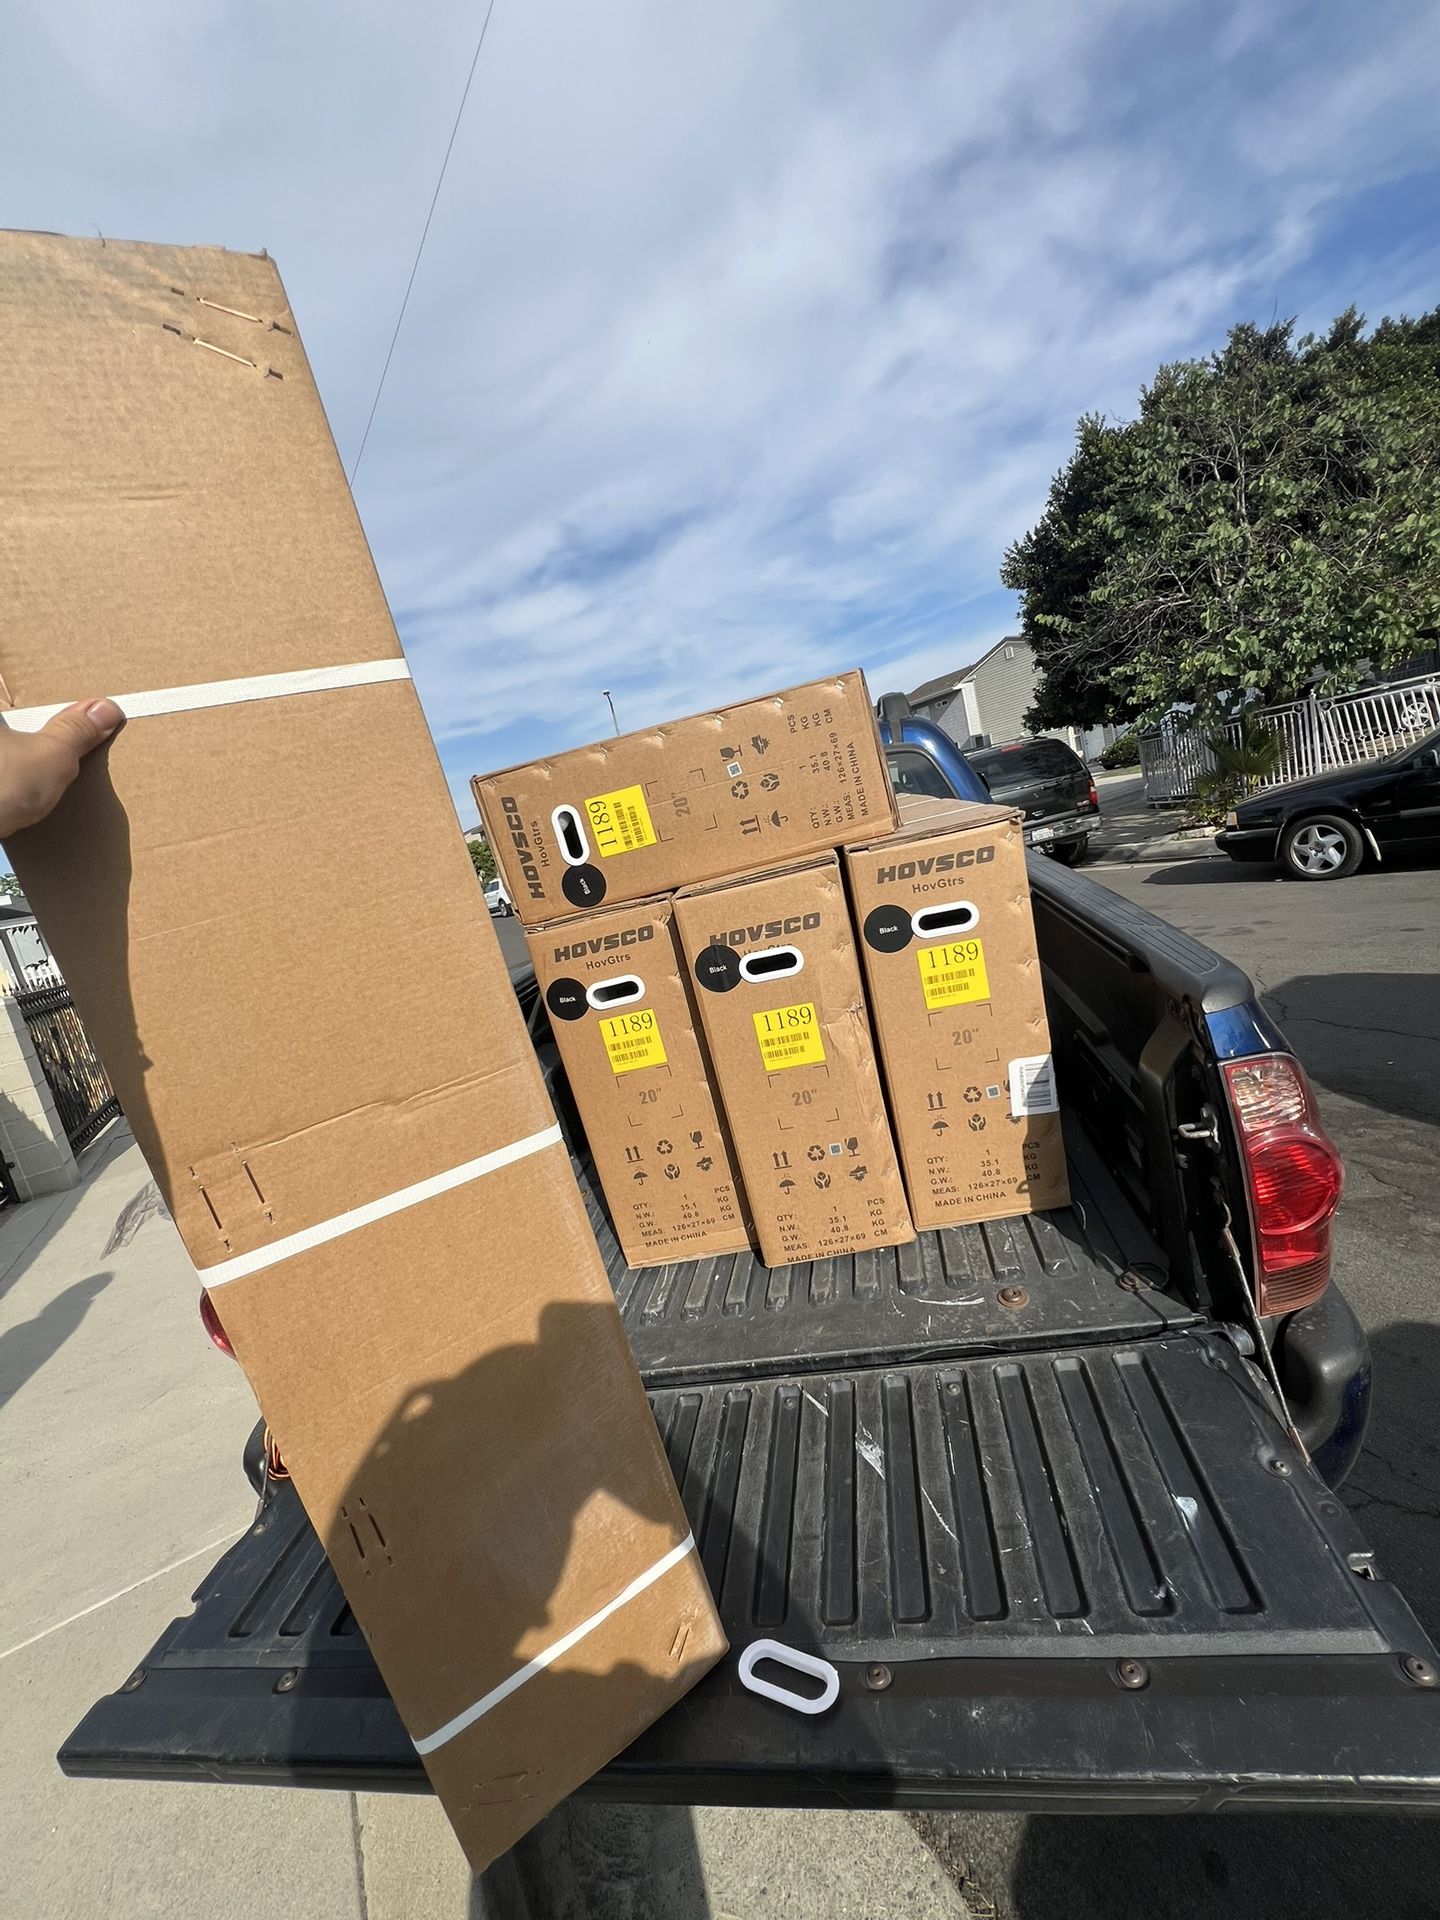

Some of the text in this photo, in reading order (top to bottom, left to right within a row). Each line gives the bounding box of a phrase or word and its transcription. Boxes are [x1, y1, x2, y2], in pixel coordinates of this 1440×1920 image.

[787, 714, 797, 733] PCS
[800, 716, 809, 730] KG
[812, 713, 821, 727] KG
[824, 708, 833, 724] CM
[809, 754, 820, 774] 35.1
[847, 742, 869, 816] MADE IN CHINA
[589, 800, 617, 848] 1189
[501, 797, 545, 898] HOVSCO
[531, 820, 549, 867] HovGtrs
[877, 845, 995, 885] HOVSCO
[579, 877, 591, 895] Black
[912, 876, 965, 894] HovGtrs
[709, 912, 821, 947] HOVSCO
[879, 925, 899, 935] Black
[554, 925, 654, 962] HOVSCO
[586, 953, 631, 970] HovGtrs
[928, 942, 979, 968] 1189
[708, 964, 728, 974] Black
[559, 996, 577, 1004] Black
[608, 1012, 653, 1037] 1189
[762, 1006, 813, 1032] 1189
[1022, 1141, 1040, 1150] PCS
[980, 1158, 1000, 1168] 35.1
[1024, 1153, 1037, 1161] KG
[1026, 1173, 1041, 1182] CM
[867, 1197, 886, 1206] PCS
[934, 1191, 1007, 1208] MADE IN CHINA
[828, 1215, 848, 1224] 35.1
[870, 1208, 883, 1217] KG
[645, 1231, 707, 1248] MADE IN CHINA
[874, 1228, 888, 1237] CM
[787, 1253, 813, 1263] MADE
[826, 1246, 856, 1256] CHINA
